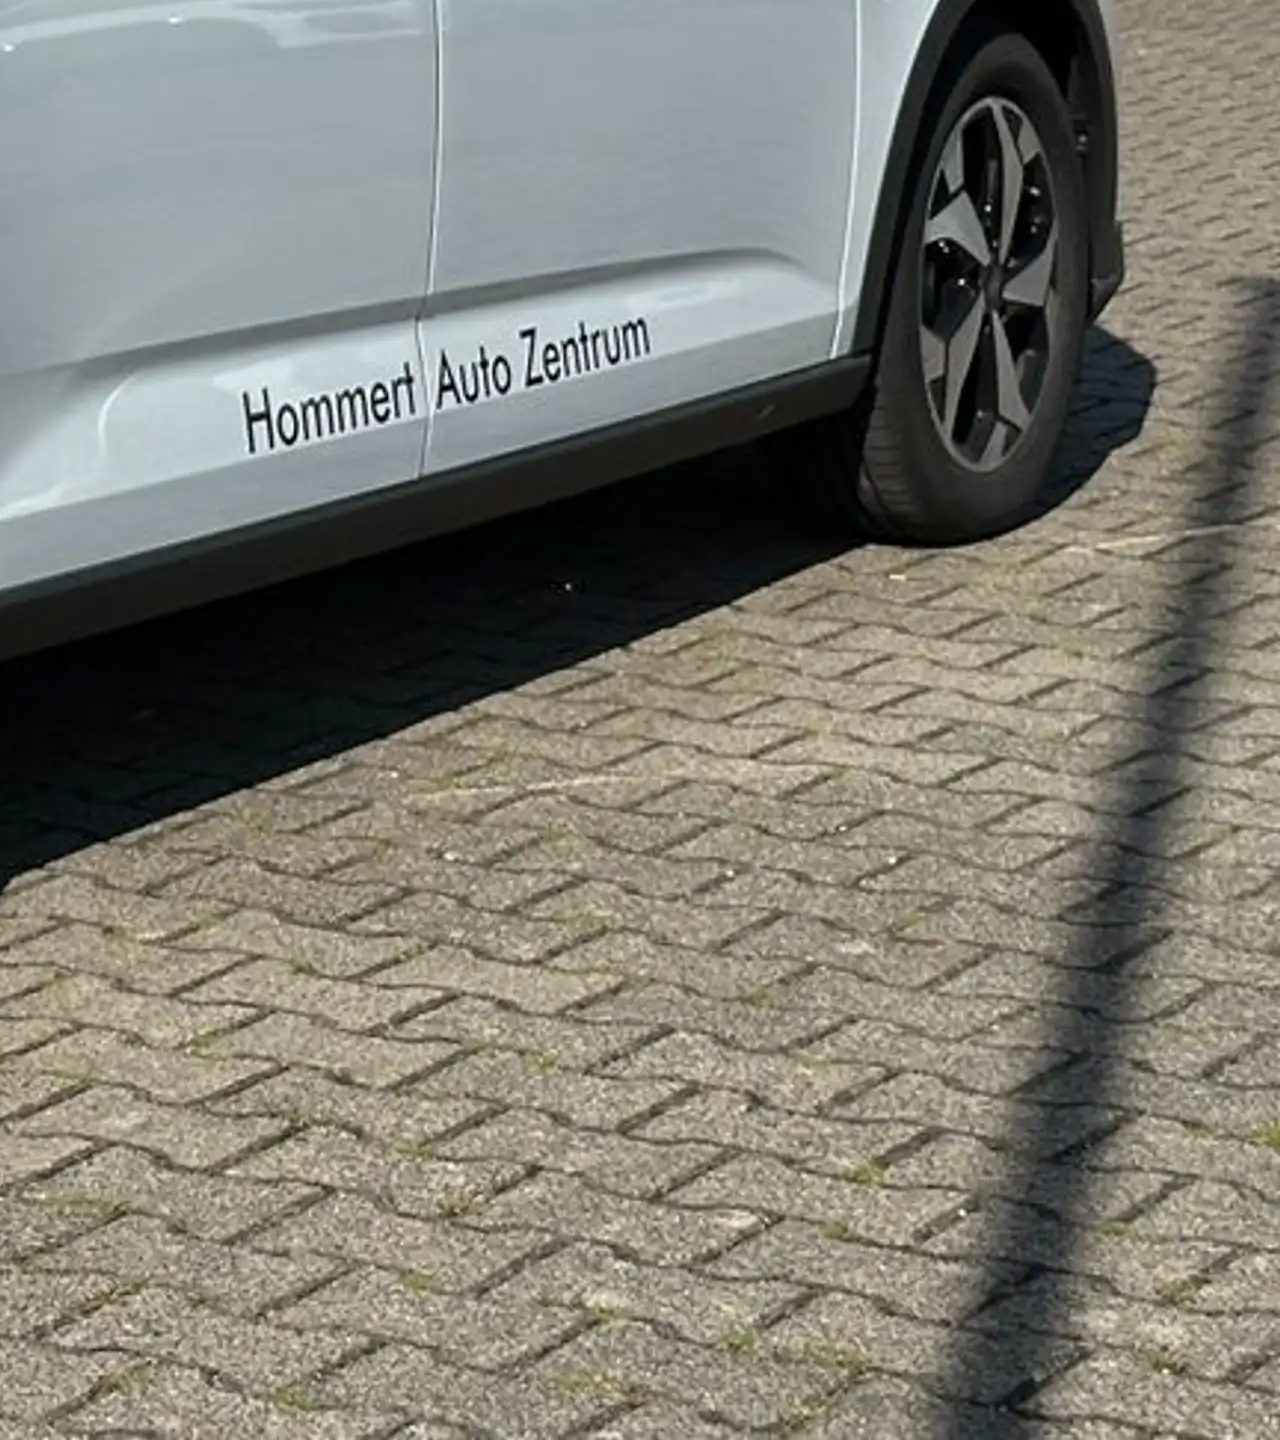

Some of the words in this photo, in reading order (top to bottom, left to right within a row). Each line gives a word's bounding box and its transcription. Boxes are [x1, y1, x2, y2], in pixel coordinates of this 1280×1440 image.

[242, 361, 416, 454] Hommert
[435, 346, 513, 411] Auto
[519, 316, 653, 388] Zentrum
